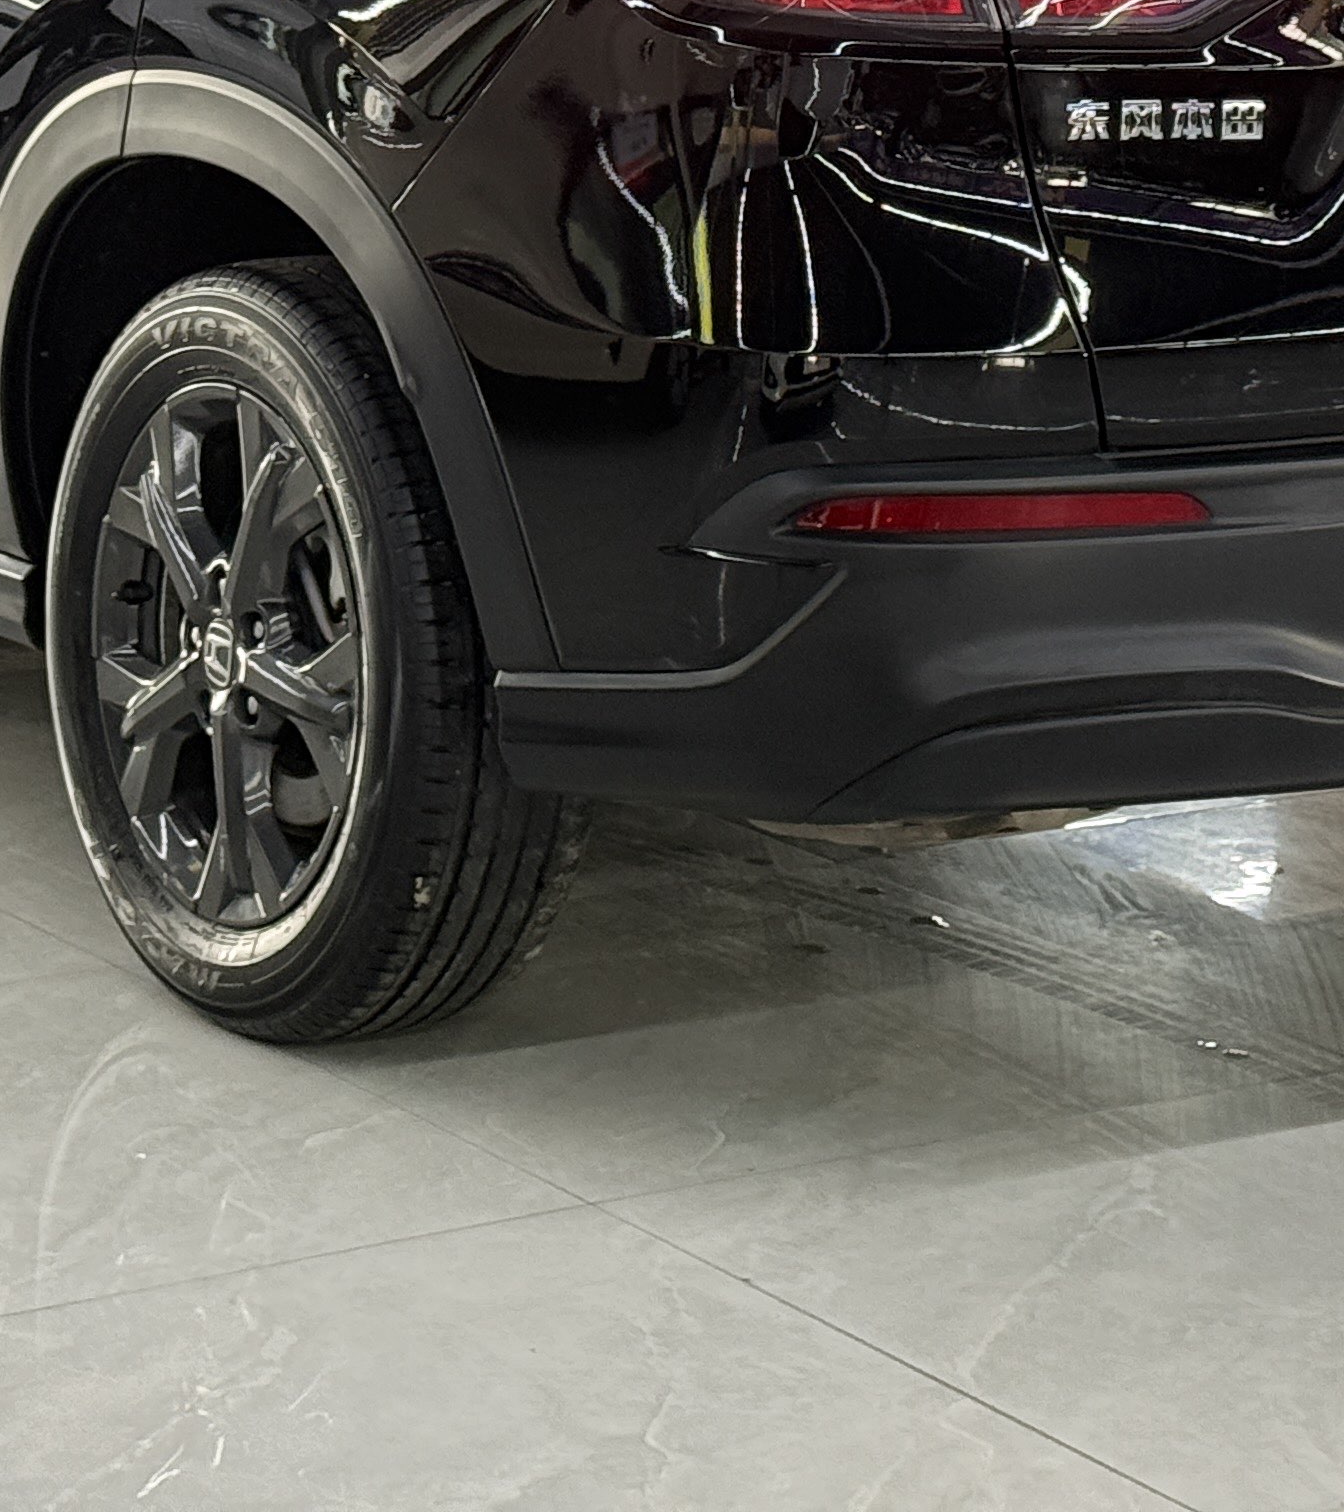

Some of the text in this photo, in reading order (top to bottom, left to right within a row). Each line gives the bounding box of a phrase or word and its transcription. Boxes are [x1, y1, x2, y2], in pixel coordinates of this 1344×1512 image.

[1065, 98, 1267, 141] 东风本田
[151, 315, 299, 401] VICTRA
